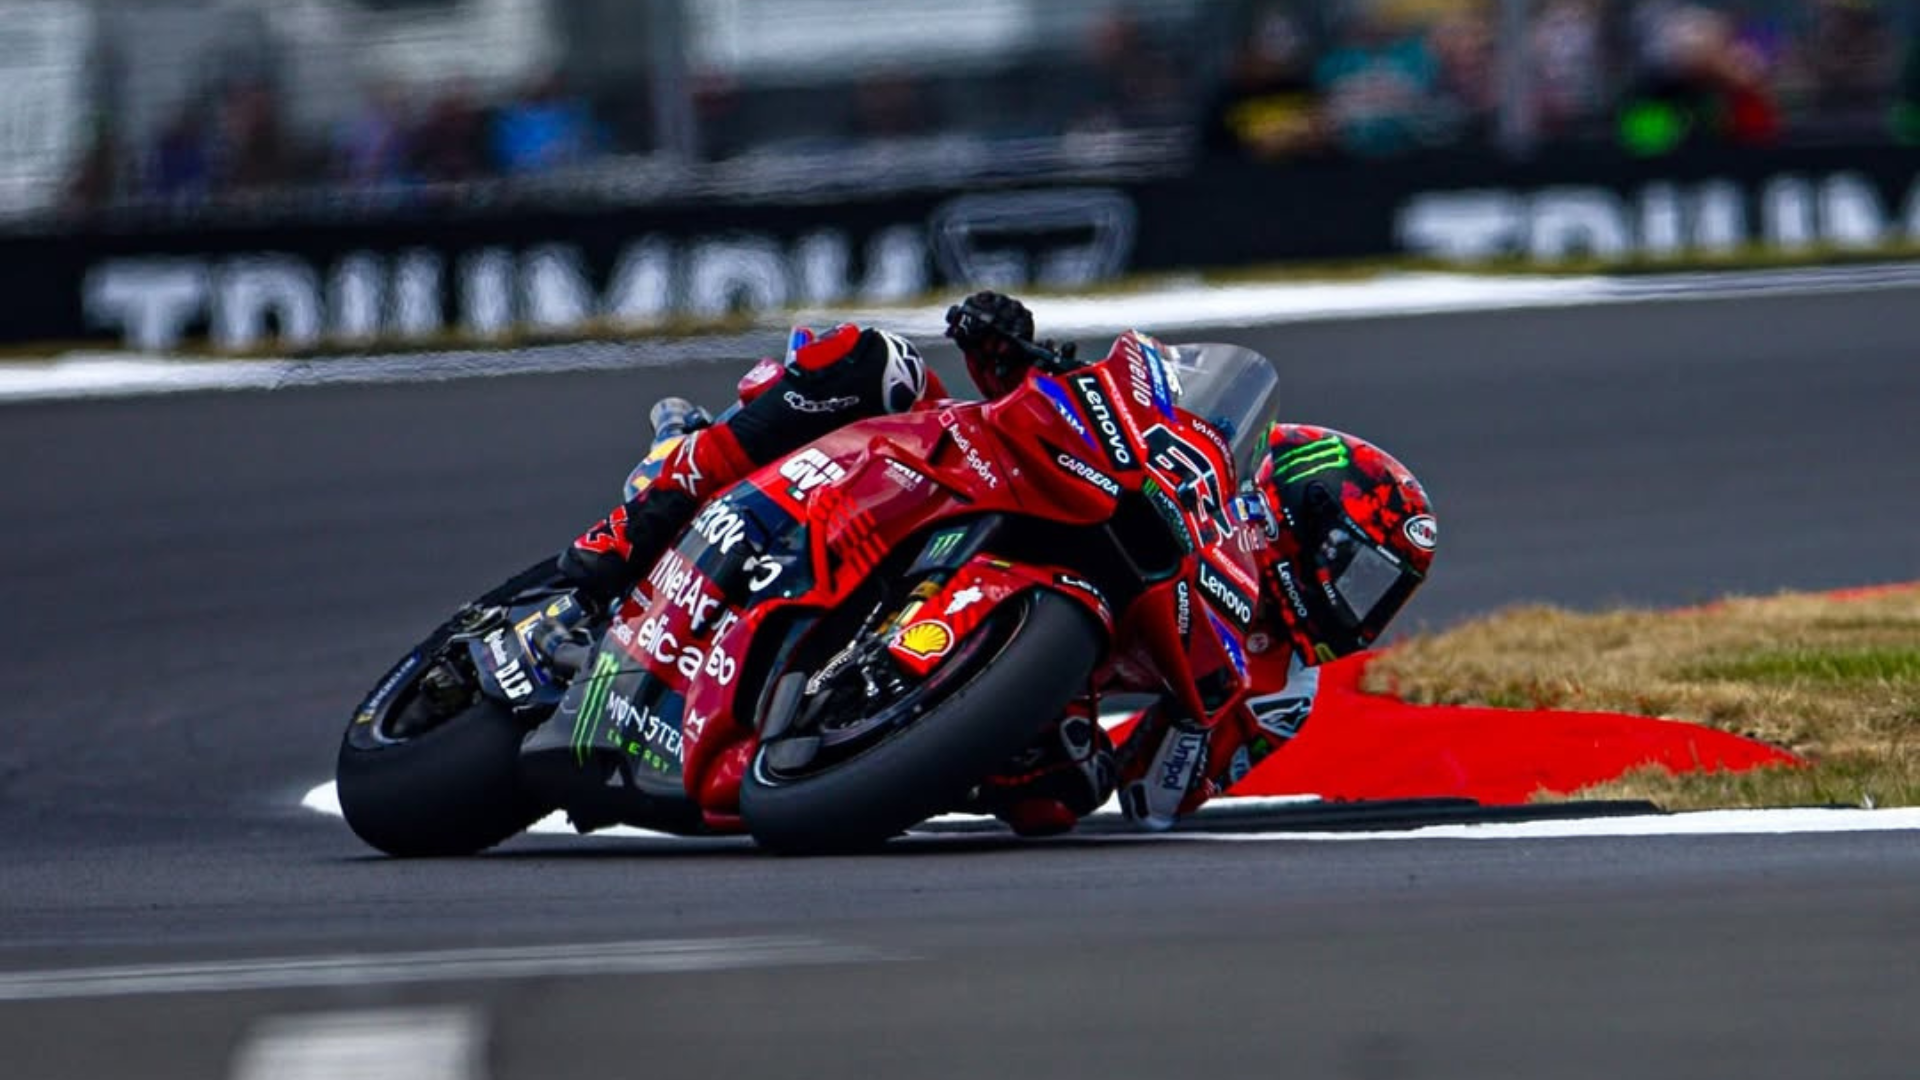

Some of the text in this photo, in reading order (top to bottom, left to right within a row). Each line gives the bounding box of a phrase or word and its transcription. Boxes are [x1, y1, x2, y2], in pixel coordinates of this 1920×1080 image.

[1121, 336, 1152, 407] riello
[1077, 377, 1130, 464] Lenovo
[949, 423, 997, 489] Audi Sport
[1057, 454, 1119, 495] CARRERA
[1200, 563, 1251, 623] Lenovo
[1277, 562, 1307, 618] Lenovo
[1162, 735, 1198, 790] Unipol
